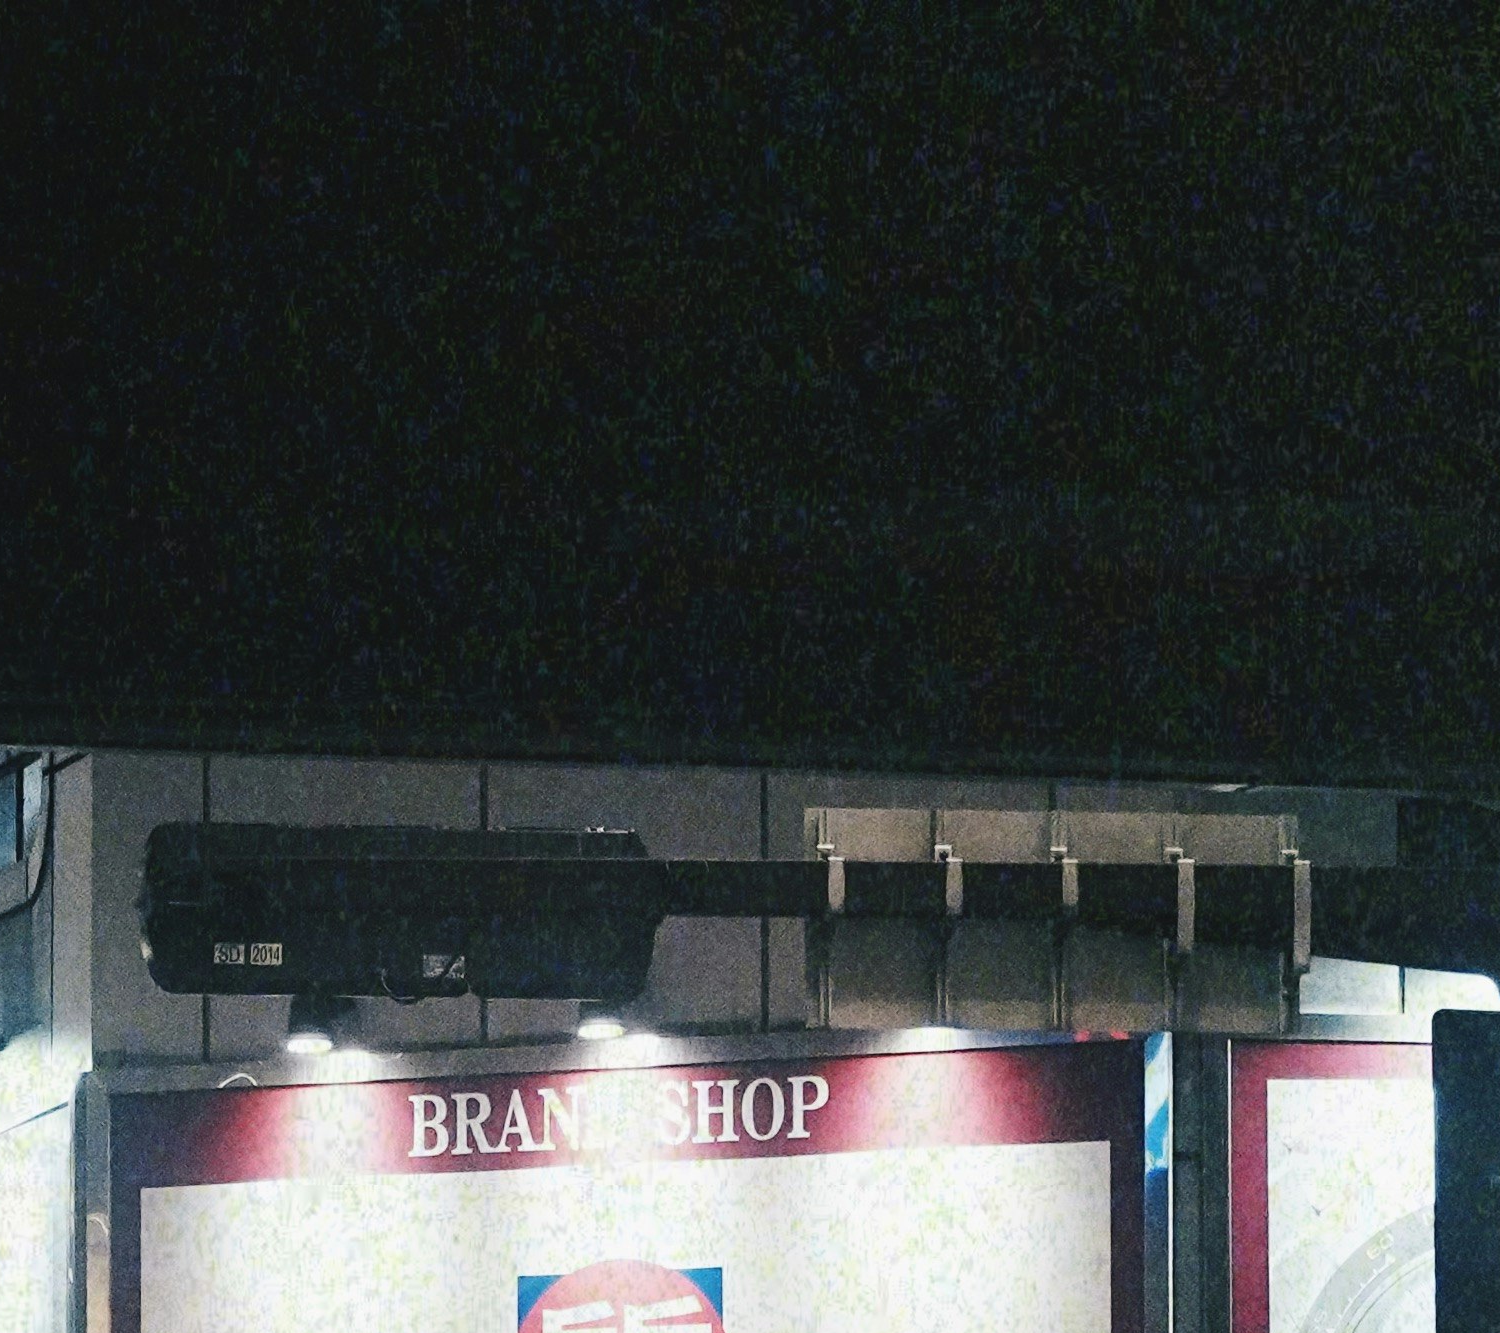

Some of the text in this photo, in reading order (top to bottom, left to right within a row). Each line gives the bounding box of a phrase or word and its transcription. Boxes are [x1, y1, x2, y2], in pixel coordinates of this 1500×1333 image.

[252, 945, 280, 963] 2014
[407, 1074, 830, 1158] BRAN SHOP
